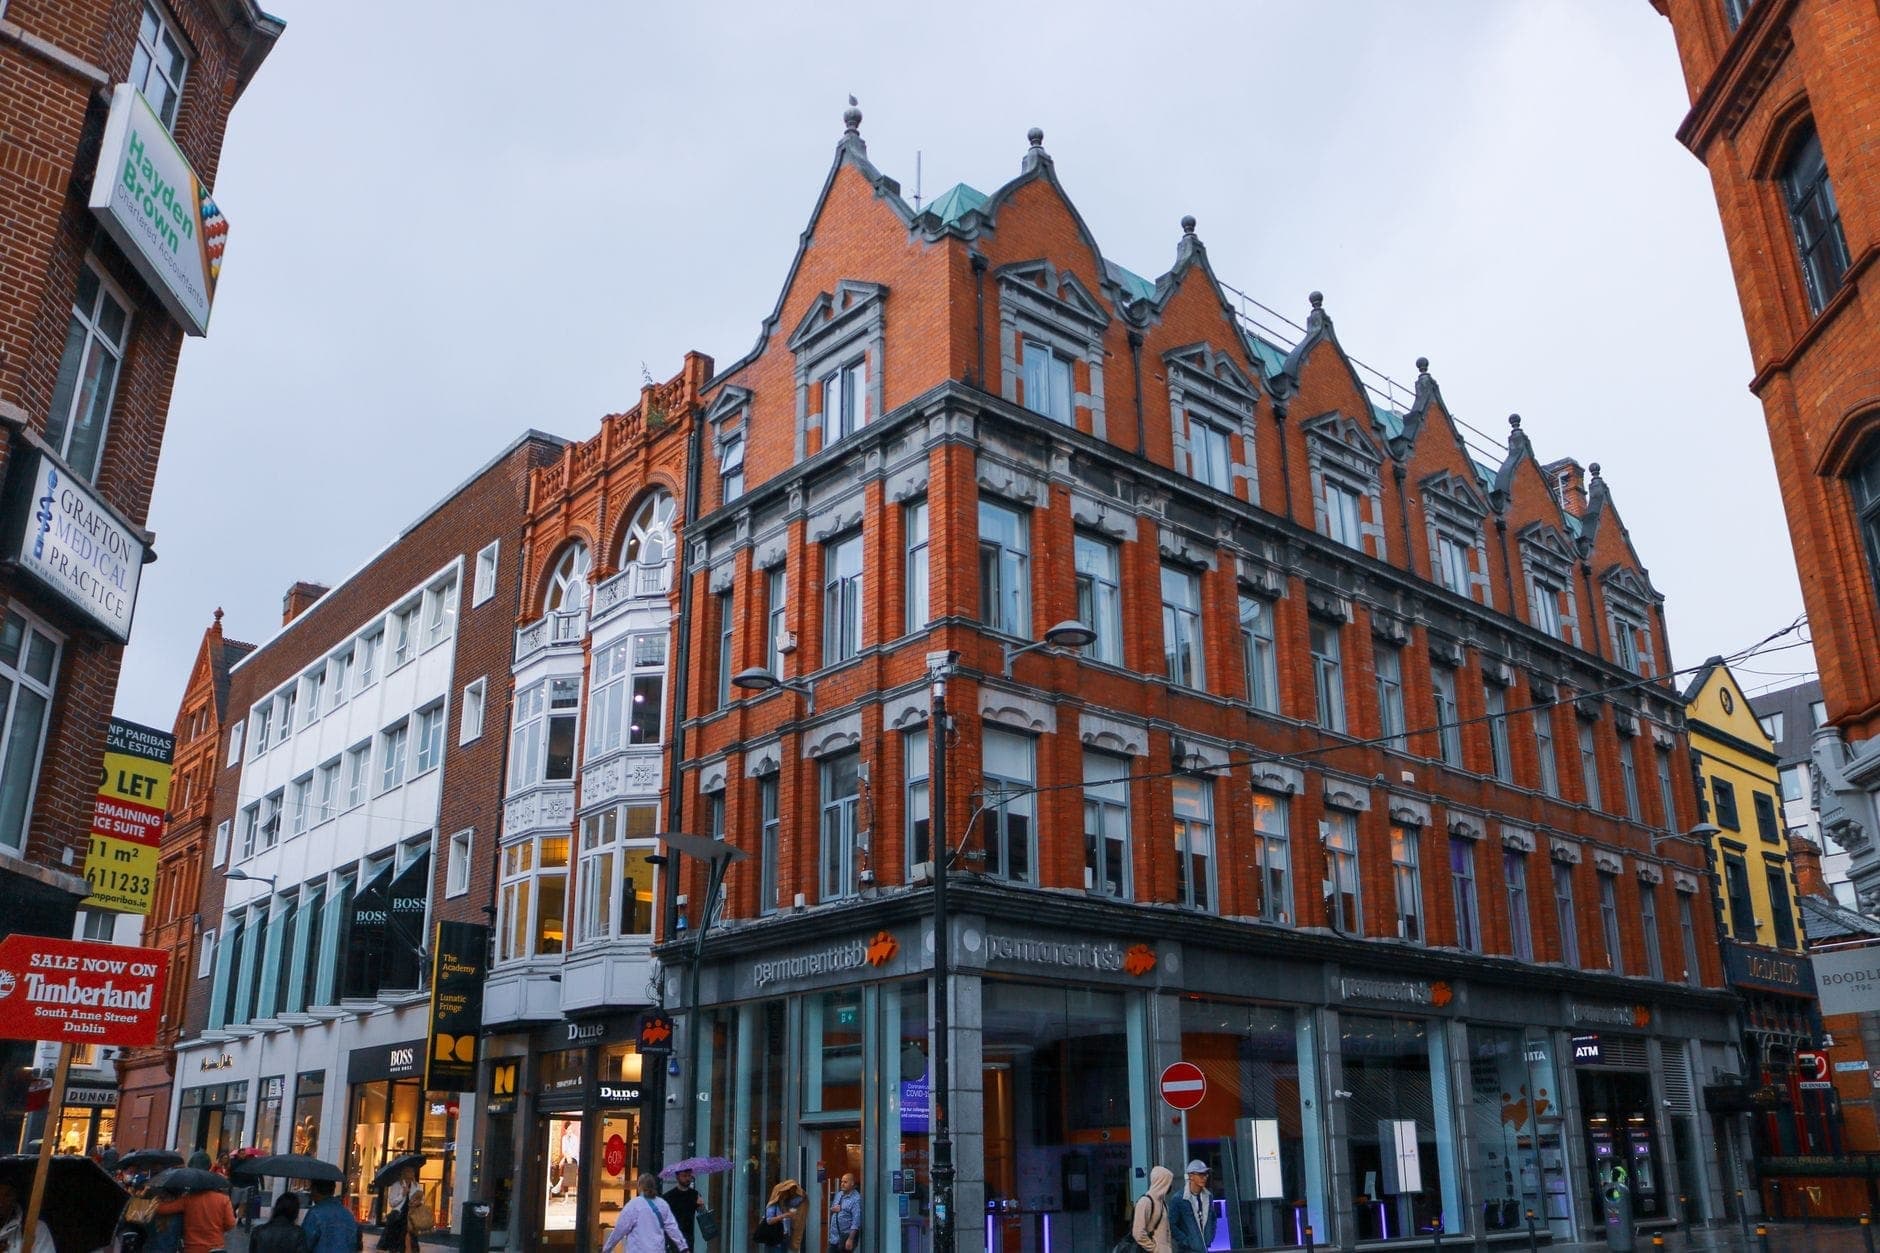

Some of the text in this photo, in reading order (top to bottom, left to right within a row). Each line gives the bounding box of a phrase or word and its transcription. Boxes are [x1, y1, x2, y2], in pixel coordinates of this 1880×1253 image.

[129, 129, 193, 240] Hayden
[123, 157, 179, 254] Brown
[118, 183, 204, 308] Chartered Accountants
[61, 489, 131, 565] GRAFTON
[55, 513, 127, 592] MEDICAL
[49, 546, 124, 619] PRACTICE
[108, 724, 172, 750] NP PARIBAS
[106, 735, 167, 760] EAL ESTATE
[117, 770, 158, 800] LET
[93, 815, 146, 838] ICE SUITE
[392, 897, 427, 909] BOSS
[355, 910, 388, 921] BOSS
[30, 953, 158, 978] SALE NOW ON
[443, 954, 458, 963] The
[442, 963, 475, 975] Academy
[24, 973, 153, 1010] Timberland
[440, 993, 467, 1003] Lunatic
[35, 1006, 138, 1024] South Anne Street
[439, 1003, 463, 1014] Fringe
[63, 1021, 106, 1034] Dublin
[567, 1023, 604, 1041] Dune
[390, 1047, 414, 1067] BOSS
[1576, 1045, 1599, 1058] ATM
[69, 1091, 117, 1101] DUNNE
[600, 1087, 639, 1098] Dune
[906, 1089, 929, 1098] COVID-1
